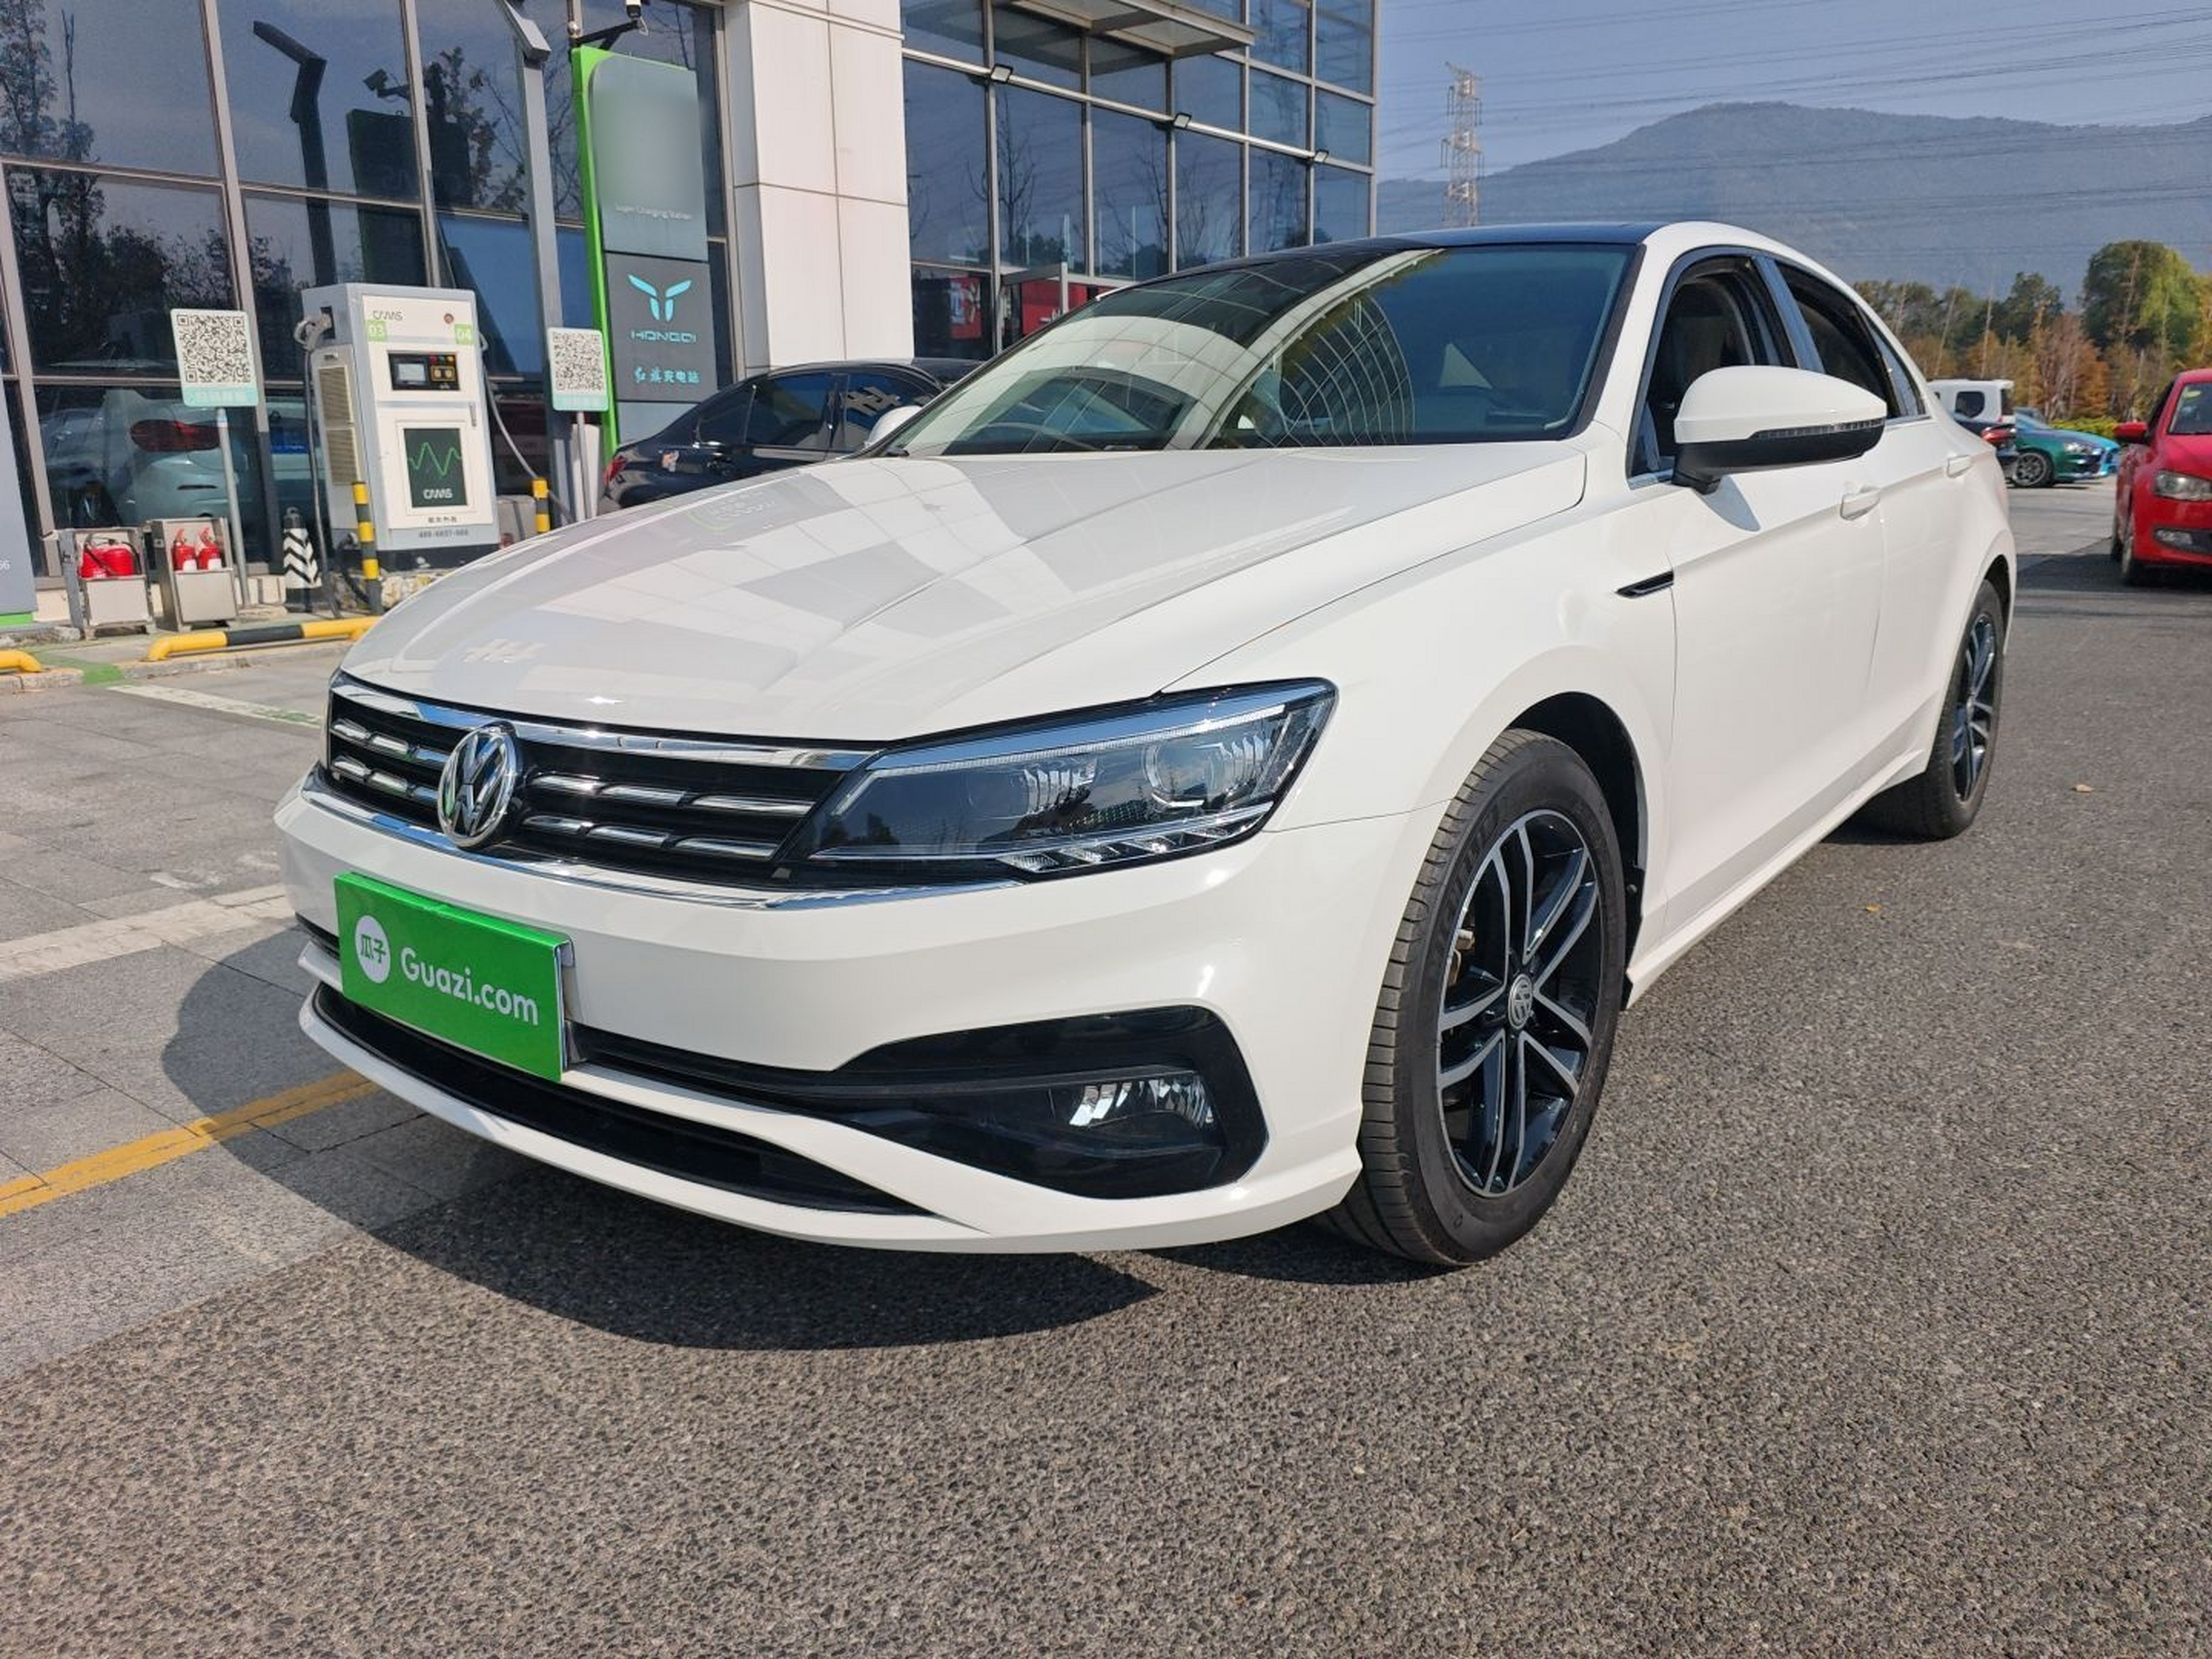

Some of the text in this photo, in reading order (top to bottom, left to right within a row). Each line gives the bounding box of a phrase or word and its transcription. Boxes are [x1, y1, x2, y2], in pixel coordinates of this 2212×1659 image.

[631, 330, 696, 343] HONGQI
[635, 366, 700, 384] 红旗充电站
[360, 933, 386, 964] 瓜子
[401, 946, 539, 1026] Guazi.com
